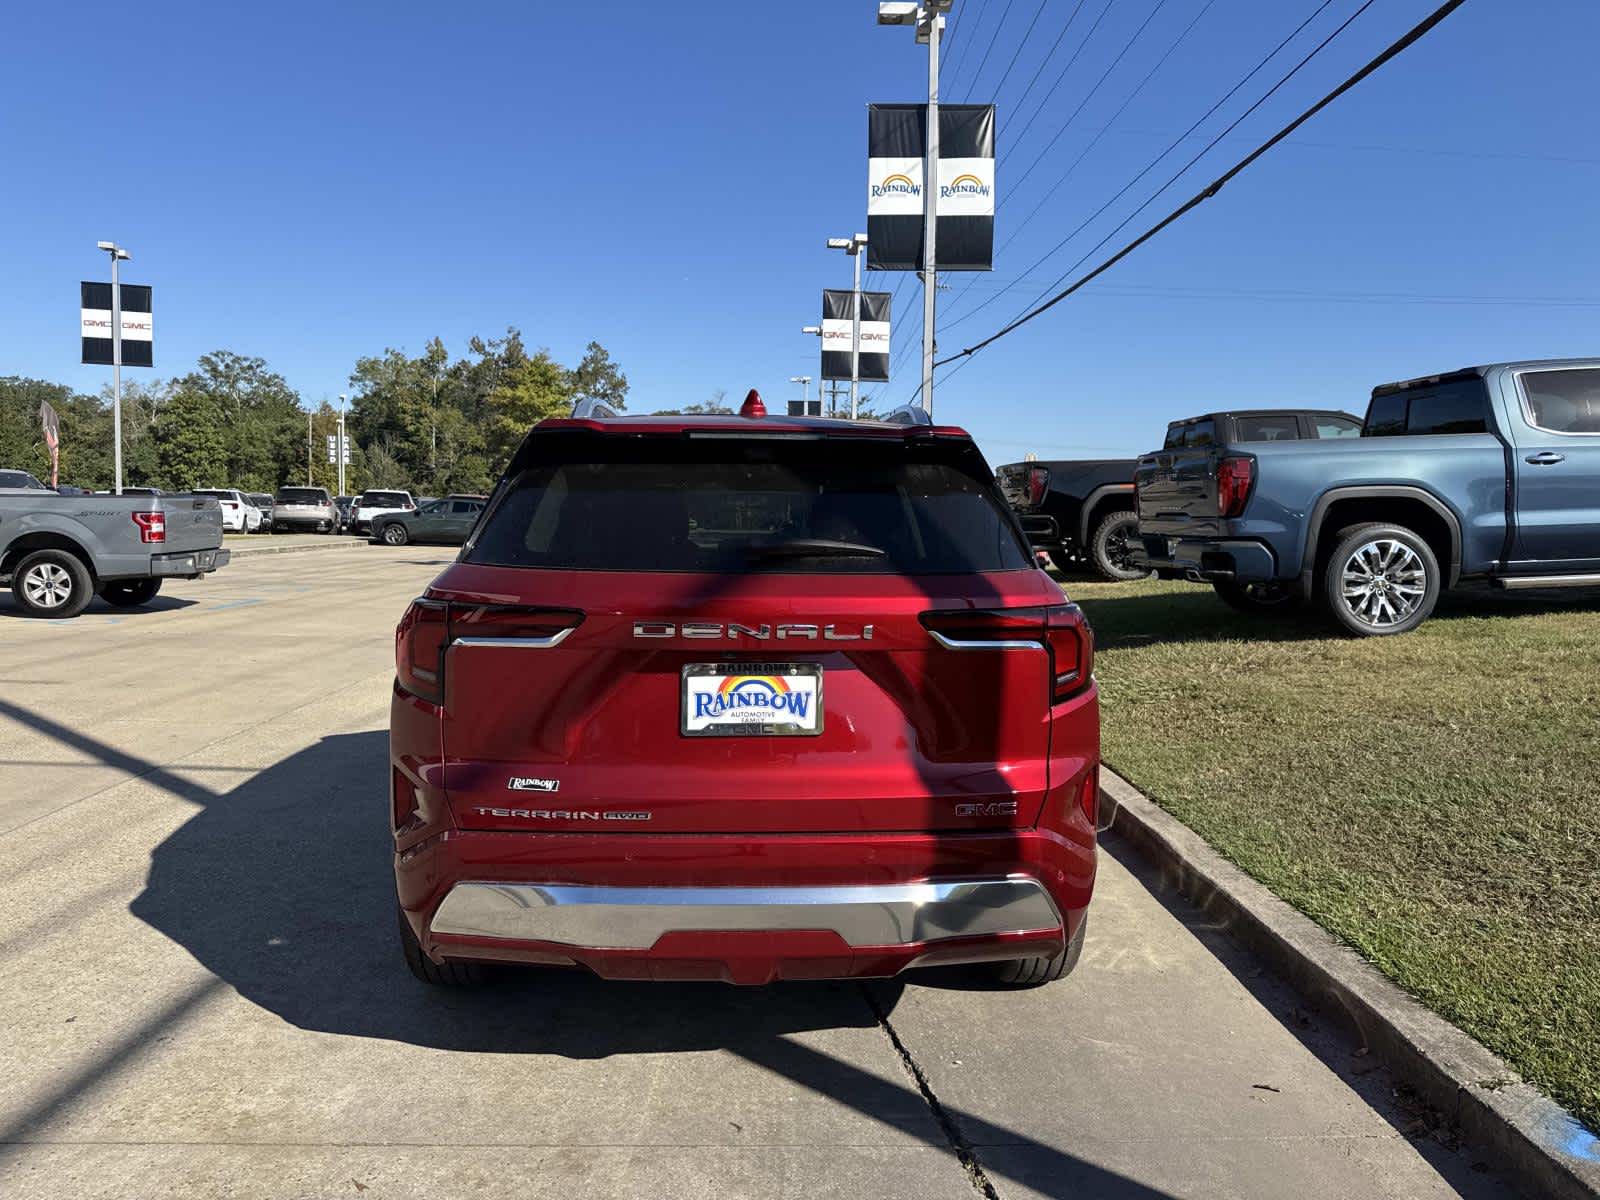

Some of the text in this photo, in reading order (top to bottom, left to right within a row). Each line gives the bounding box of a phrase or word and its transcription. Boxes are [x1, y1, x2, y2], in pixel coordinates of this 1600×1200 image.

[872, 184, 921, 197] RAINBOW
[941, 185, 990, 198] RAINBOW
[122, 322, 151, 330] GMC
[824, 331, 851, 339] GMC
[633, 622, 873, 640] DENALI
[694, 692, 811, 718] RAINBOW
[513, 777, 555, 791] RAINBOW
[473, 806, 600, 820] TERRAIN
[955, 801, 1017, 816] GMC
